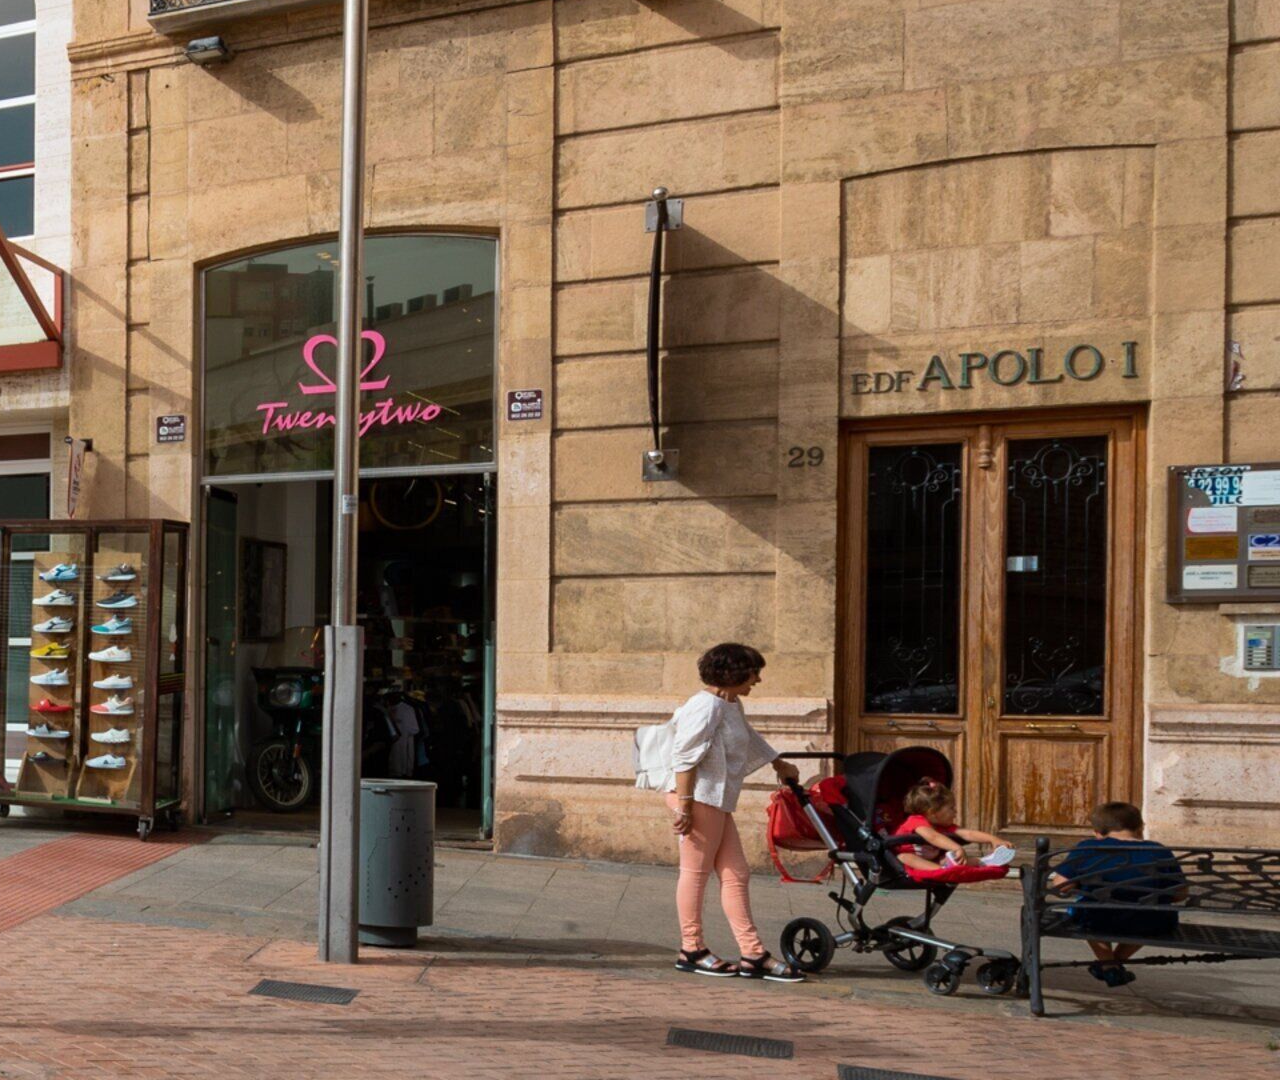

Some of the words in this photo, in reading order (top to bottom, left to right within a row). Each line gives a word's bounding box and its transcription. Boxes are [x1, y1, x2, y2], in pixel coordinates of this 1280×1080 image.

[850, 371, 915, 395] EDF
[916, 344, 1105, 392] APOLO
[1122, 341, 1139, 378] I
[256, 398, 442, 438] Twenytwo
[788, 446, 825, 468] 29
